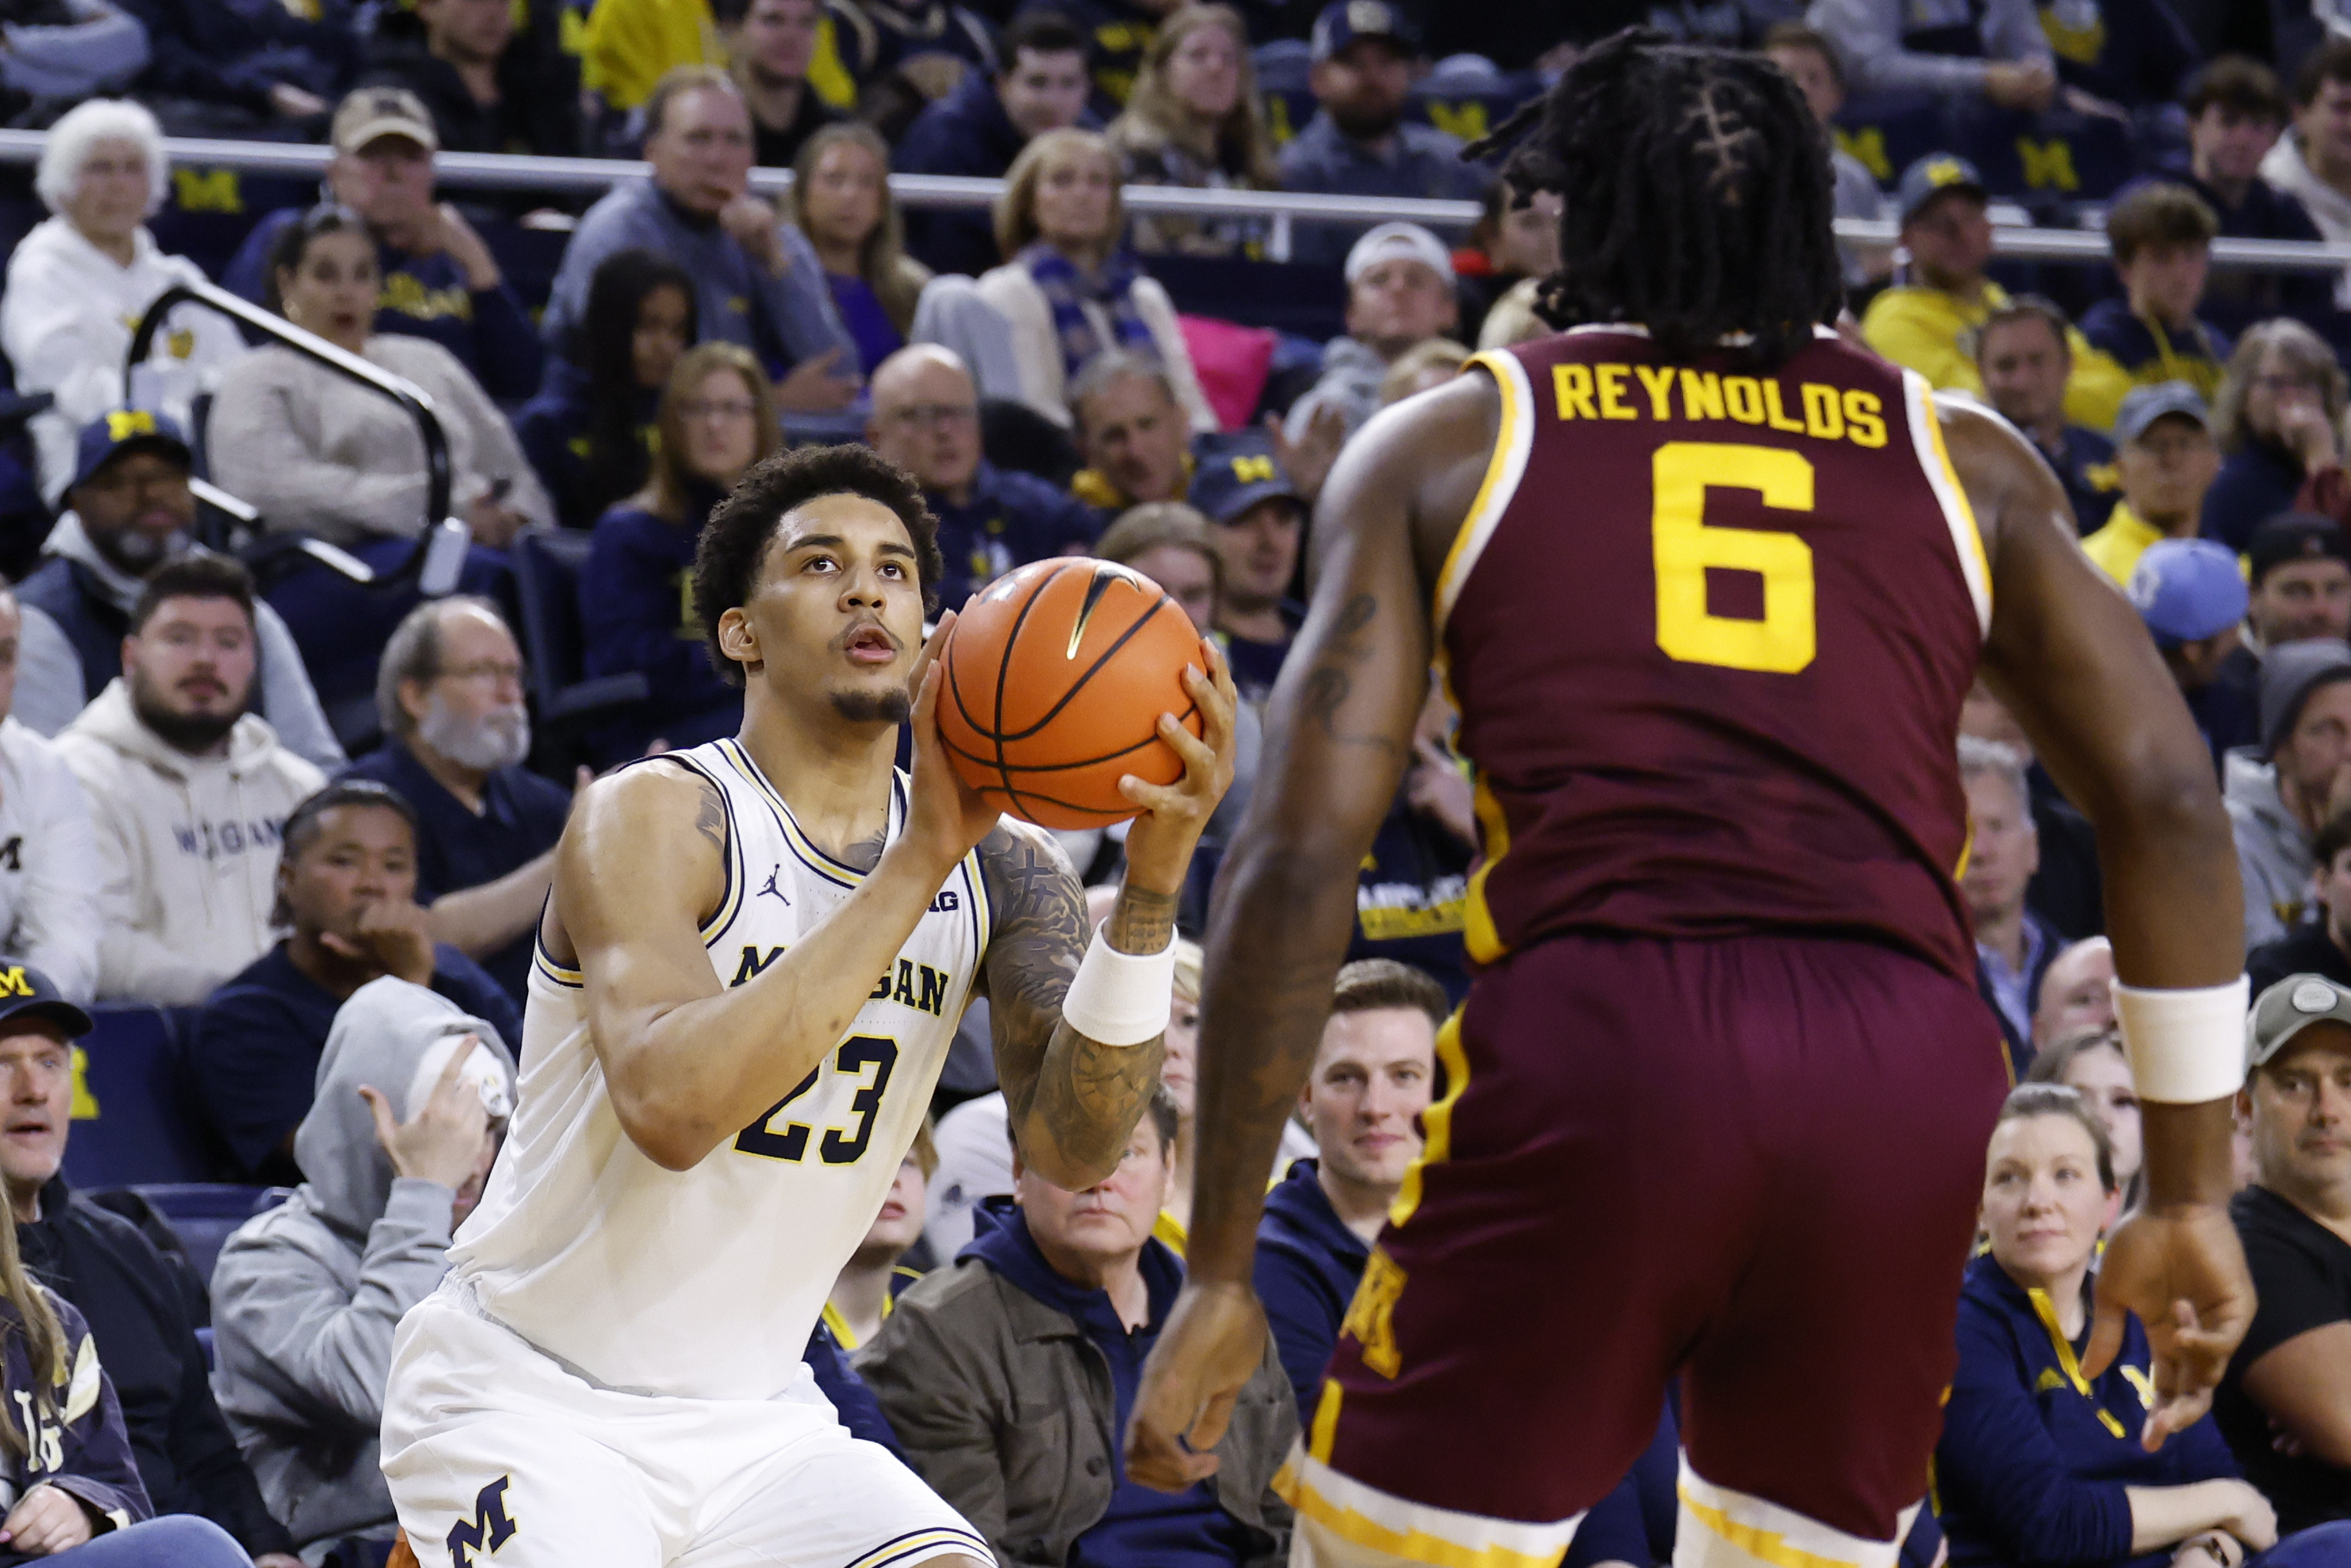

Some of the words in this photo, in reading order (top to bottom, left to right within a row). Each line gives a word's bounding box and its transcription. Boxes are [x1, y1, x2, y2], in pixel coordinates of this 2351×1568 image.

[1552, 363, 1889, 449] REYNOLDS
[1652, 440, 1816, 675] 6
[730, 1032, 901, 1167] 23
[446, 1472, 518, 1568] M
